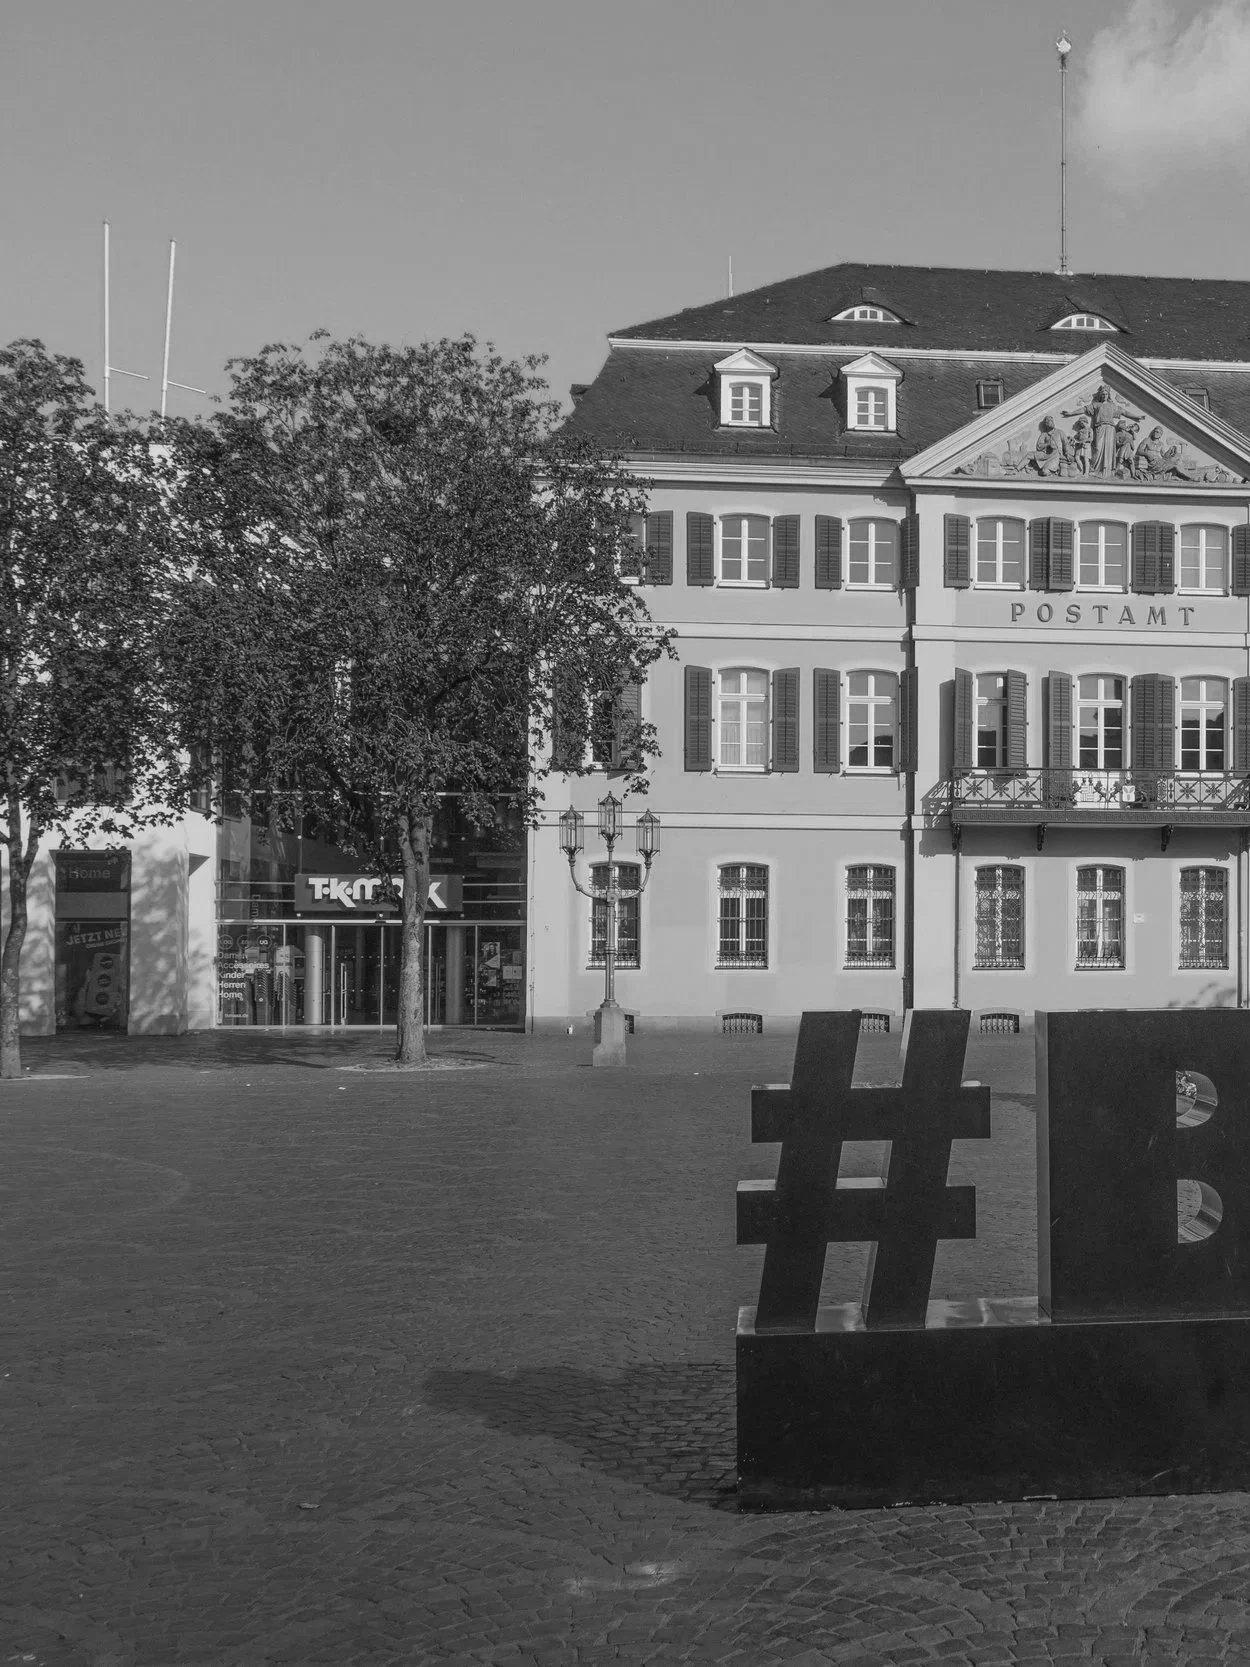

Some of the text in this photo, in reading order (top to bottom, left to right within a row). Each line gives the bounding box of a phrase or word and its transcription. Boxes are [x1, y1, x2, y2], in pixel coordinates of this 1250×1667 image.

[1010, 602, 1195, 626] POSTAMT
[69, 866, 112, 880] Home
[65, 931, 103, 946] JETZT
[217, 970, 246, 979] Kinder
[217, 980, 246, 989] Herren
[217, 990, 244, 999] Home
